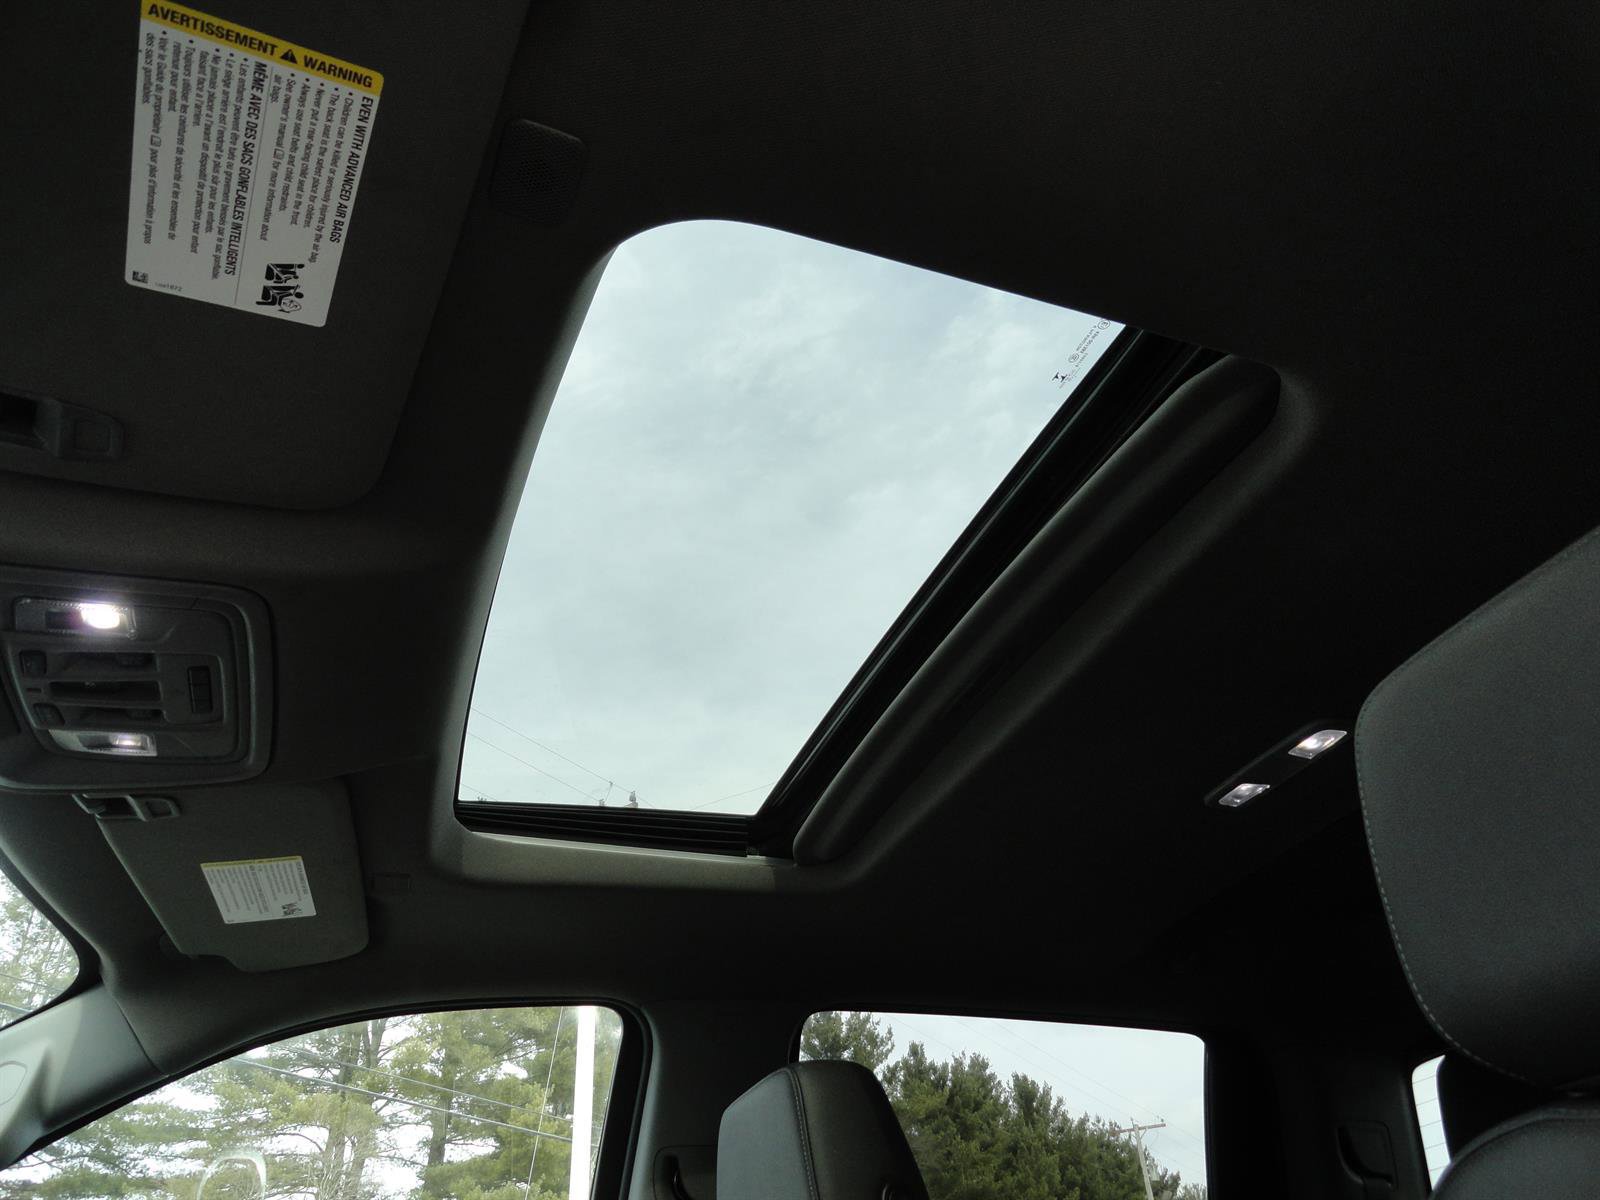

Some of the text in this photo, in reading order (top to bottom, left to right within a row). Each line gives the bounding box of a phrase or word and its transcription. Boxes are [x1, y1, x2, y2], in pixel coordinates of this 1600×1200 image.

[148, 3, 373, 89] AVERTISSEMENT WARNING
[224, 60, 270, 276] MÊME AVEC DES SACS GONFLABLES INTELLIGENTS
[329, 95, 373, 243] EVEN WITH ADVANCED AIR BAGS
